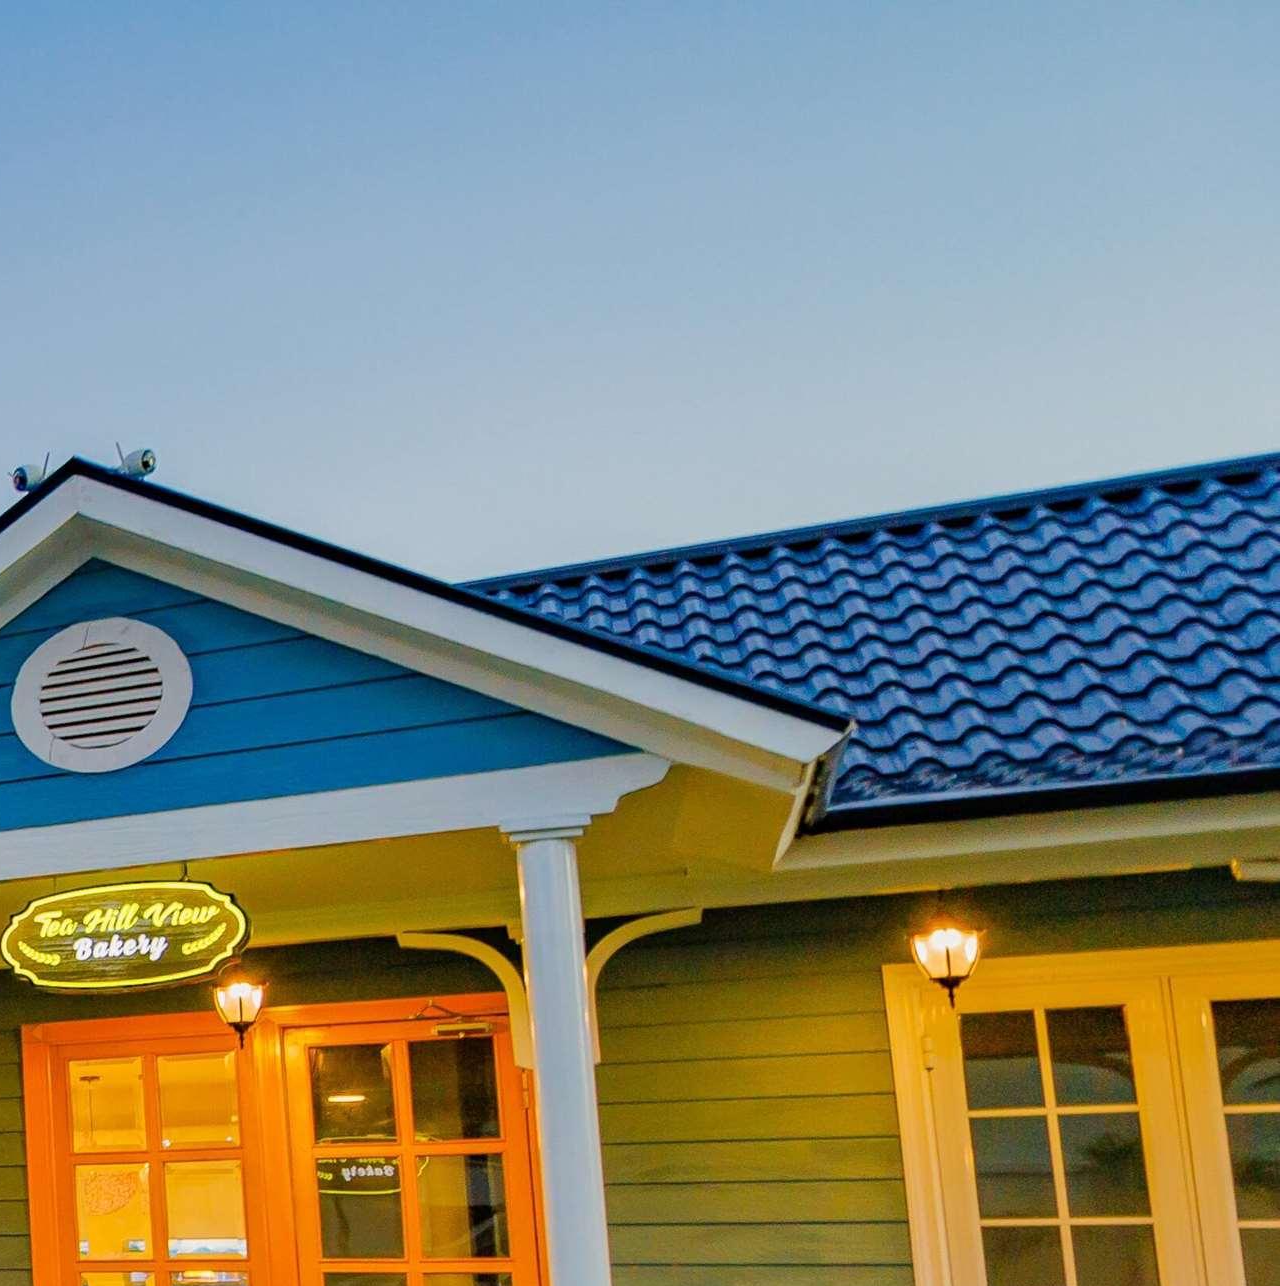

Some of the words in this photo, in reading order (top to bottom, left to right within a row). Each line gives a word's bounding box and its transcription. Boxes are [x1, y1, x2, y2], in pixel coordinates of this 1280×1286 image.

[34, 910, 78, 938] Tea
[82, 903, 139, 934] Hill
[143, 901, 220, 927] View
[73, 933, 168, 961] Bakery
